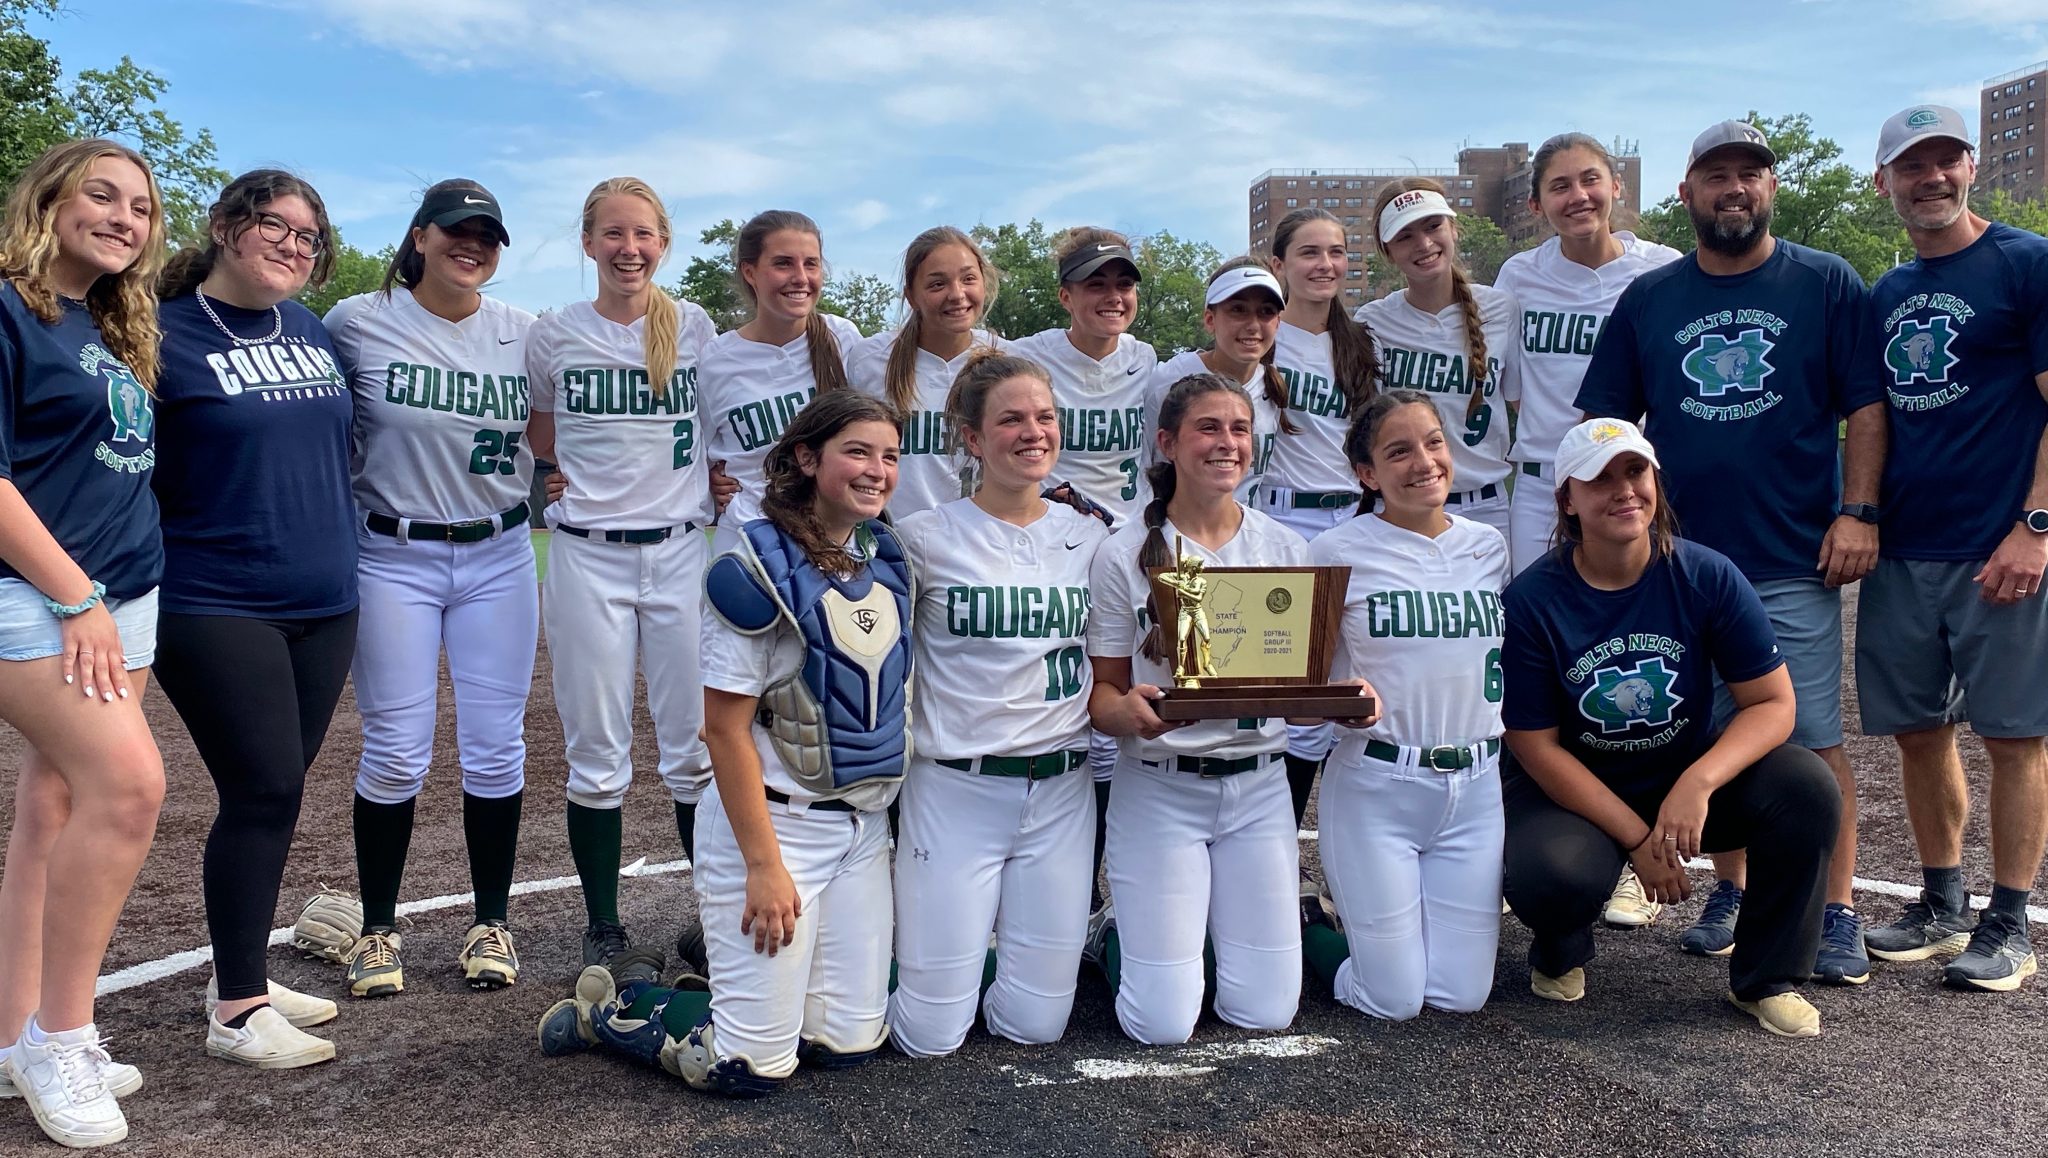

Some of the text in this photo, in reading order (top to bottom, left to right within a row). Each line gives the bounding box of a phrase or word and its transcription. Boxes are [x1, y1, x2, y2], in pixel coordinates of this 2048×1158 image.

[1394, 192, 1424, 208] USA
[1675, 309, 1788, 345] COLTS NECK
[1884, 293, 1975, 332] COLTS NECK
[261, 386, 341, 402] SOFTBALL
[385, 362, 529, 421] COUGARS
[563, 366, 697, 415] COUGARS
[1680, 391, 1783, 421] SOFTBALL
[673, 420, 694, 471] 2
[1463, 404, 1492, 447] 9
[469, 428, 523, 476] 25
[1120, 458, 1139, 502] 3
[1045, 646, 1083, 701] 10
[1483, 648, 1503, 703] 6
[1566, 634, 1686, 683] COLTS NECK
